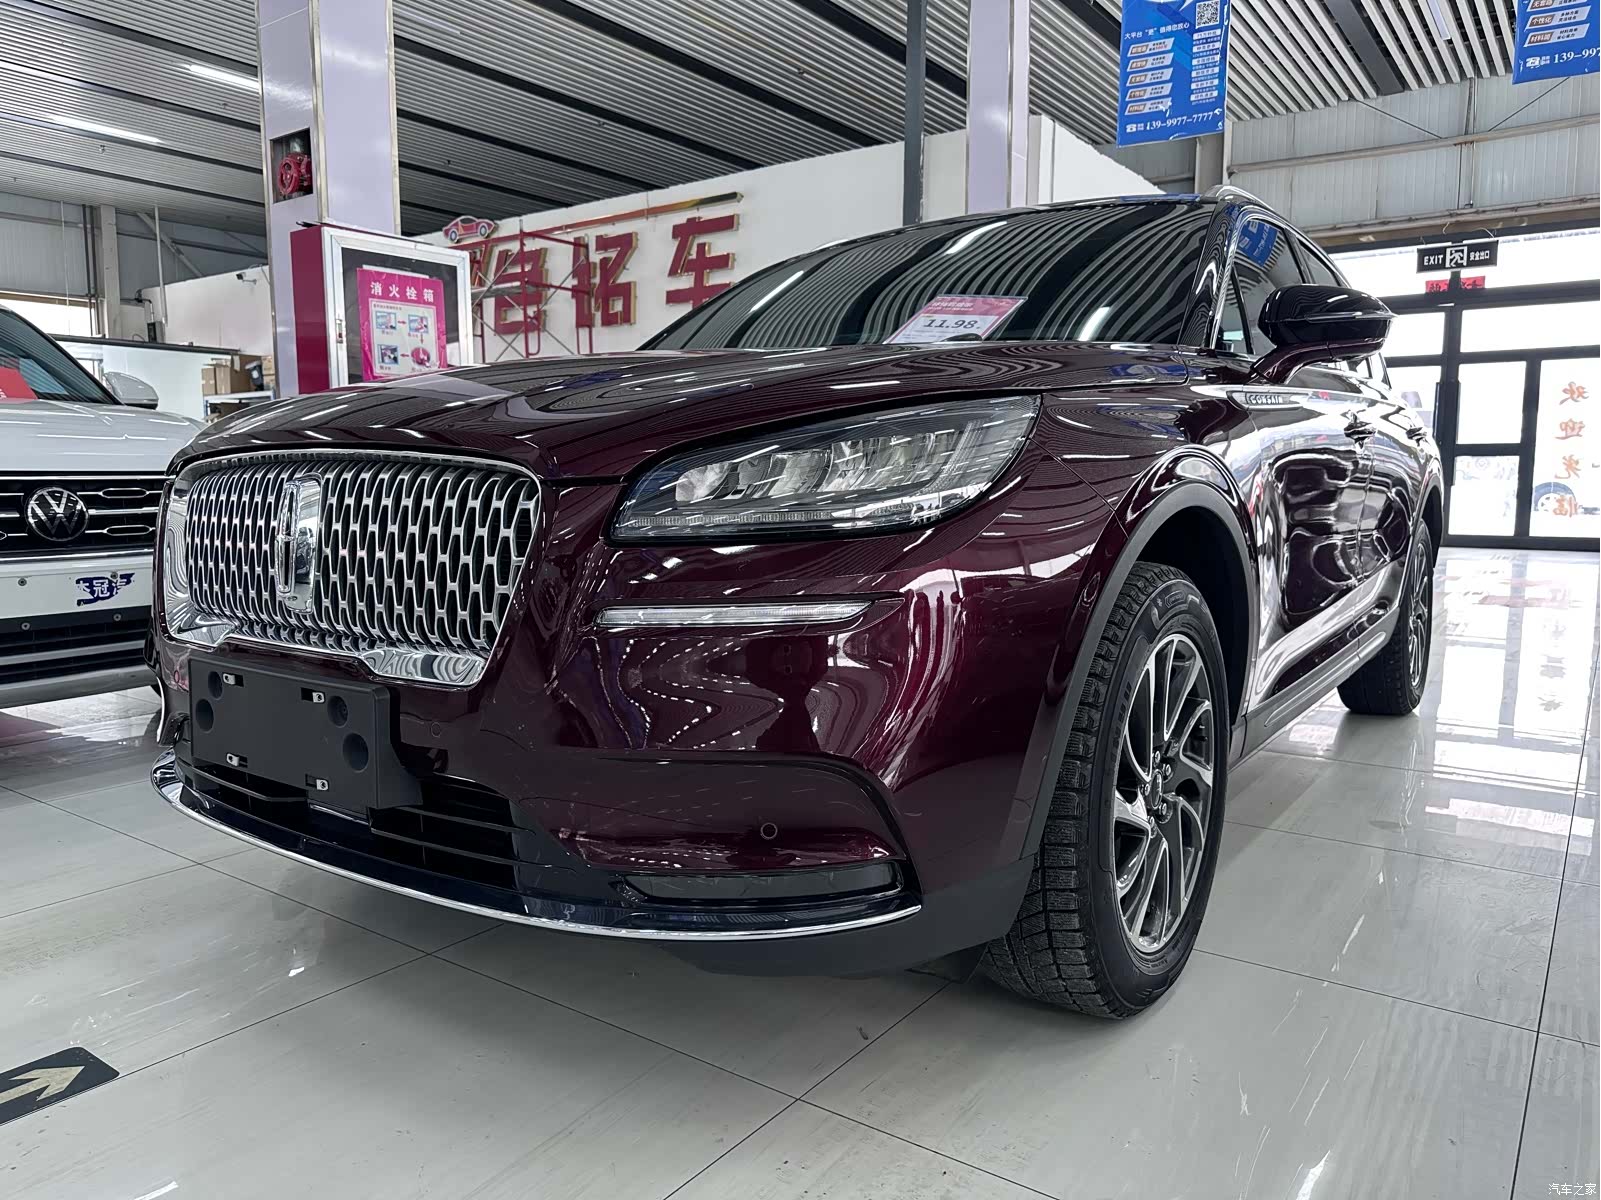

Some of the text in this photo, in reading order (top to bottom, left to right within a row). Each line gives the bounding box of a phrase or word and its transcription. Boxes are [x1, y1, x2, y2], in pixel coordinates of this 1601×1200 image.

[1423, 254, 1443, 266] EXIT
[1469, 250, 1490, 261] 安全出口
[370, 281, 434, 303] 消火栓箱
